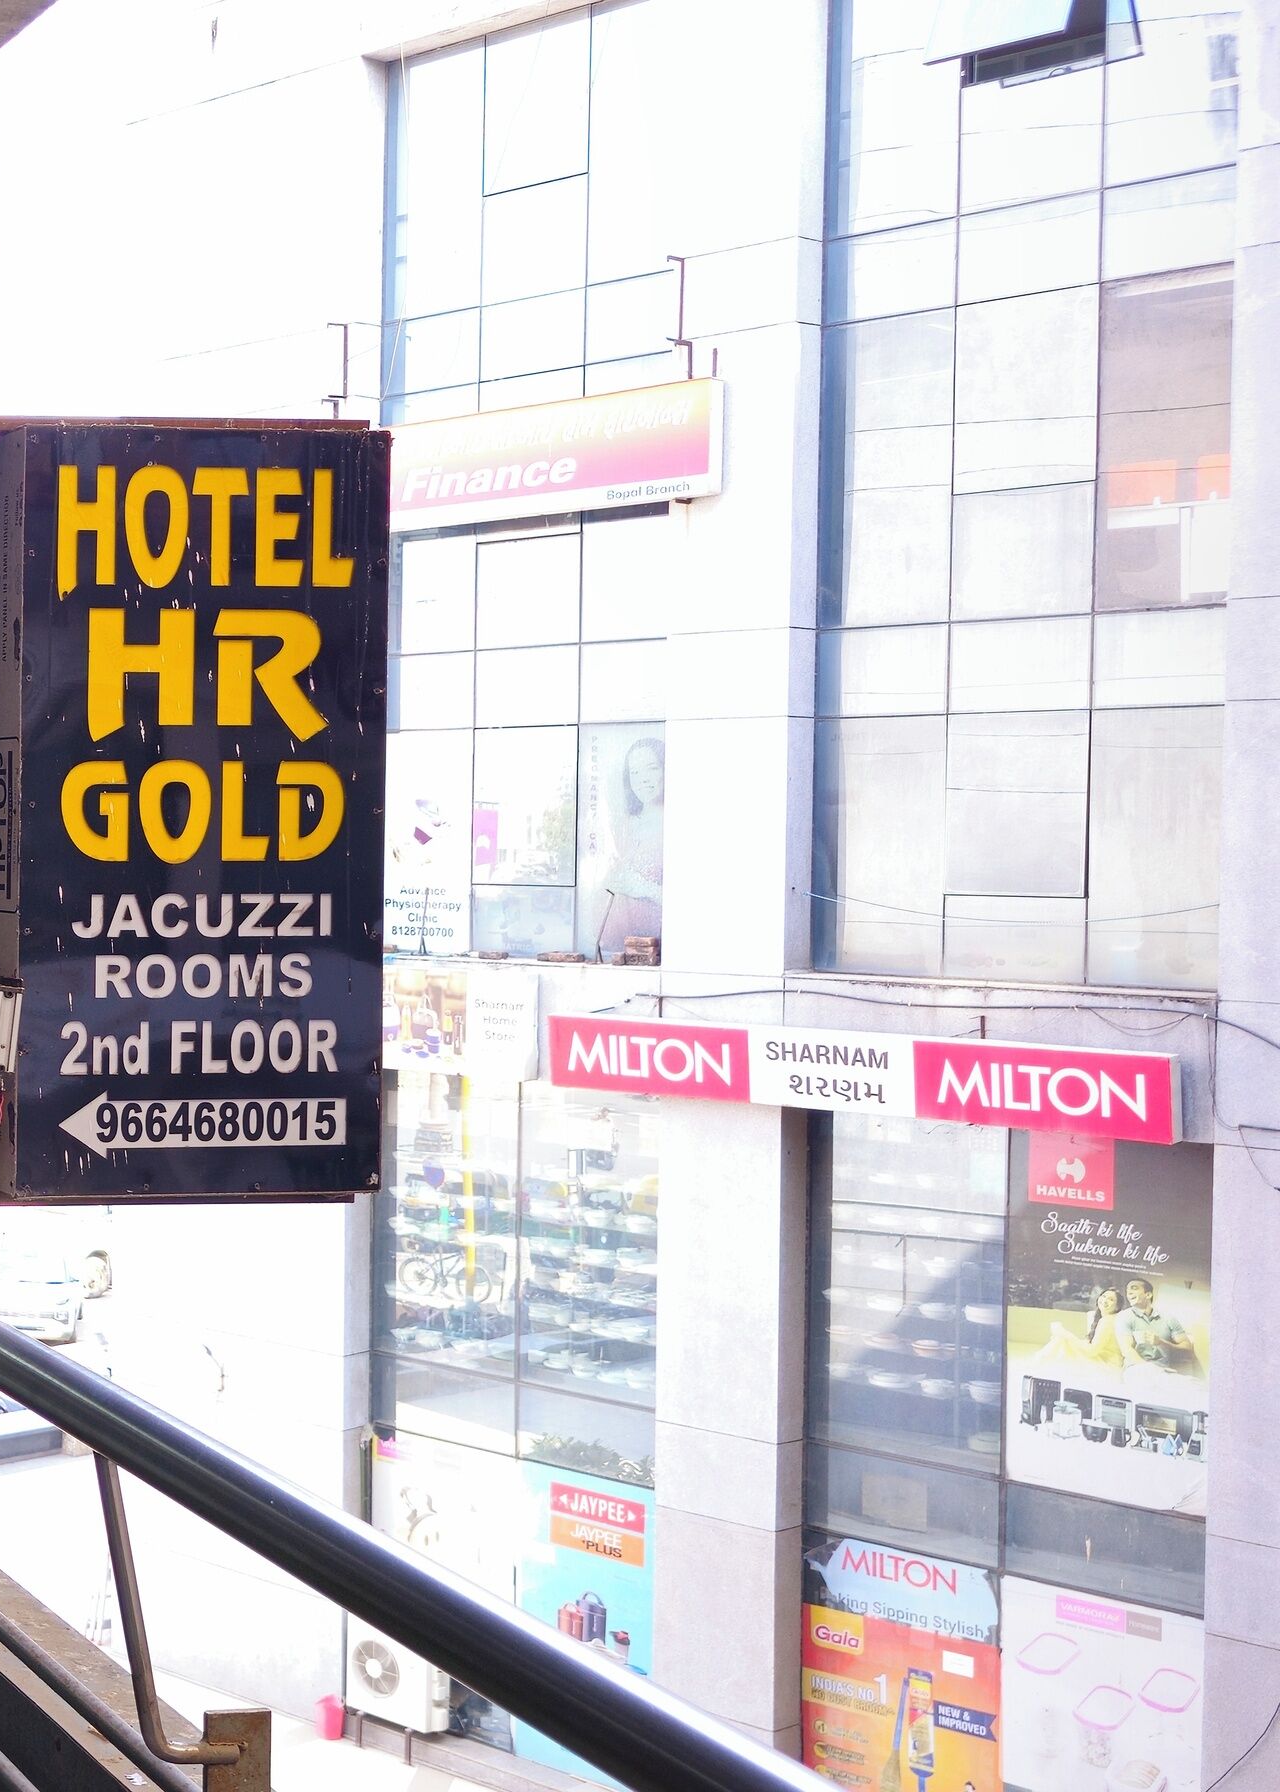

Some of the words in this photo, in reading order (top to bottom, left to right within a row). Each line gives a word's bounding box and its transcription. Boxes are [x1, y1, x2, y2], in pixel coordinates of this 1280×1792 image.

[400, 456, 578, 502] Finance
[646, 482, 690, 498] Branch
[56, 464, 355, 601] HOTEL
[87, 608, 330, 742] HR
[60, 760, 346, 863] GOLD
[71, 893, 333, 938] JACUZZI
[94, 952, 313, 999] ROOMS
[59, 1020, 150, 1076] 2nd
[170, 1019, 339, 1074] FLOOR
[567, 1030, 732, 1088] MILTON
[766, 1041, 889, 1070] SHARNAM
[789, 1073, 886, 1104] શરણમ
[937, 1058, 1147, 1123] MILTON
[95, 1100, 338, 1142] 9664680015
[1035, 1184, 1105, 1202] HAVELLS
[1041, 1211, 1096, 1235] Saath
[1096, 1221, 1113, 1238] ki
[1116, 1224, 1143, 1244] life
[1058, 1232, 1121, 1257] Sukoon
[1123, 1243, 1141, 1260] ki
[1143, 1245, 1169, 1266] life
[570, 1493, 626, 1523] JAYPEE
[570, 1522, 623, 1548] JAYPEE
[841, 1546, 958, 1595] MILTON
[815, 1625, 860, 1649] Gala
[872, 1601, 928, 1628] Sipping
[933, 1615, 985, 1639] Stylish
[811, 1674, 855, 1698] INDIA'S
[938, 1705, 960, 1719] NEW
[962, 1711, 970, 1721] &
[938, 1715, 987, 1736] IMPROVED
